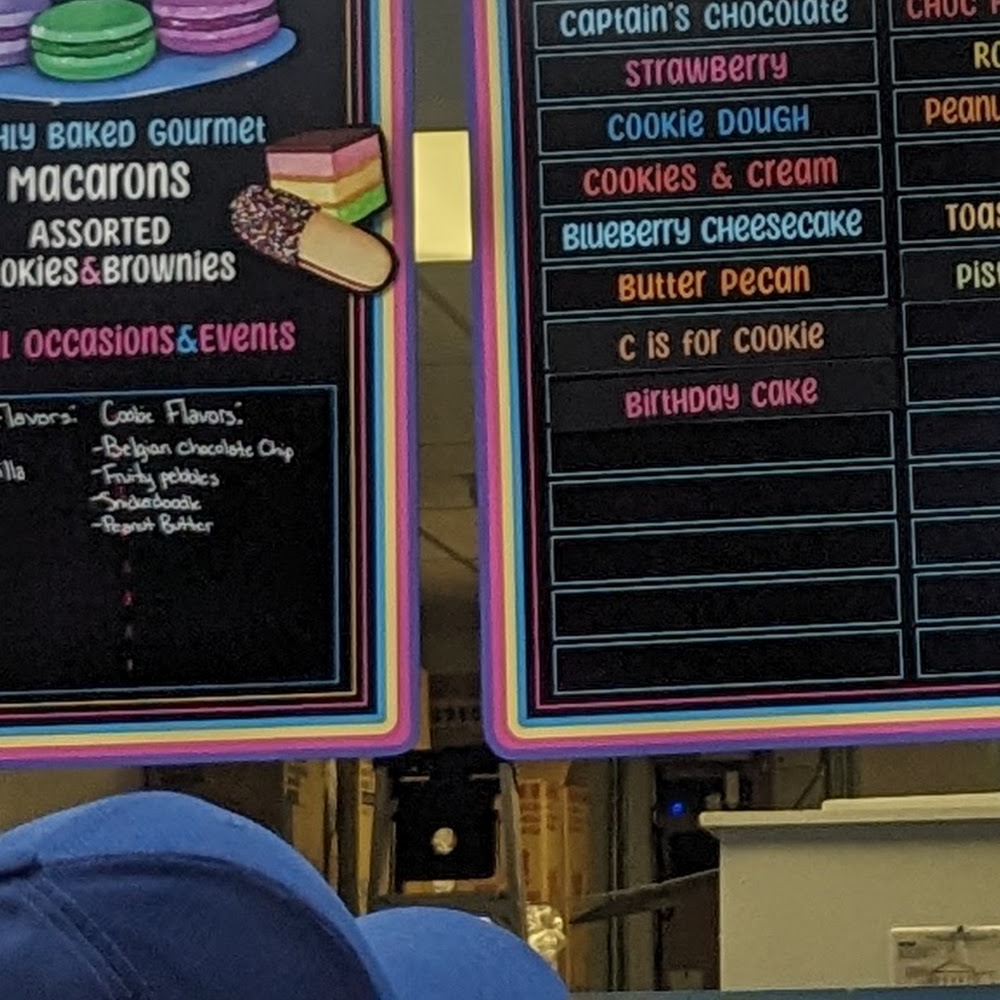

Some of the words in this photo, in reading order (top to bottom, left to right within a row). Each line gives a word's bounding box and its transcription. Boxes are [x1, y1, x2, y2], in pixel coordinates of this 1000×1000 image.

[560, 2, 690, 37] Captain's
[625, 51, 788, 88] STrawBerry
[48, 119, 135, 150] BaKeD
[148, 115, 266, 148] Gourmet
[607, 108, 704, 141] COOKie
[717, 103, 810, 136] DOUGH
[8, 160, 190, 202] Macarons
[582, 161, 697, 196] COOKies
[711, 161, 733, 190] &
[746, 155, 839, 188] Cream
[29, 216, 170, 248] ASSORTED
[562, 216, 690, 251] BlueBerry
[701, 208, 863, 243] CHeesecake
[618, 269, 707, 302] Butter
[720, 264, 810, 296] Pecan
[618, 334, 636, 361] C
[648, 331, 671, 359] is
[682, 328, 722, 356] for
[733, 320, 825, 352] COOKie
[625, 380, 740, 419] BirtHDay
[751, 376, 819, 408] Cake
